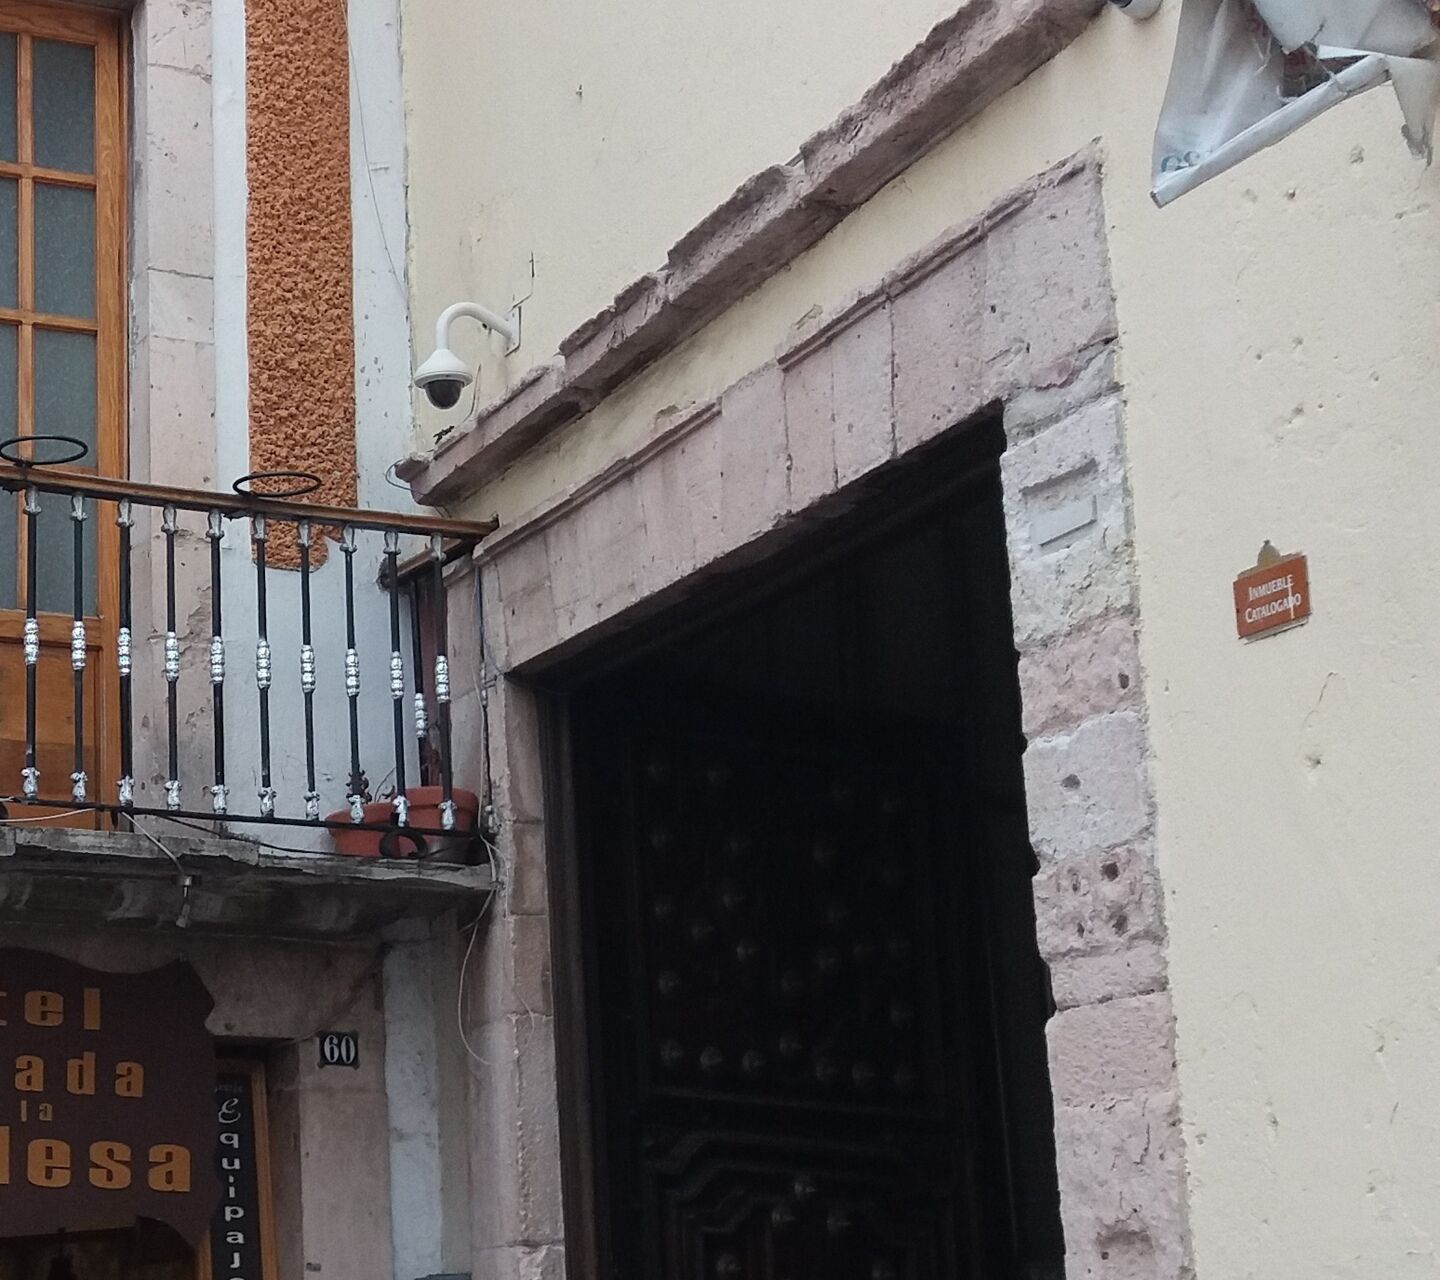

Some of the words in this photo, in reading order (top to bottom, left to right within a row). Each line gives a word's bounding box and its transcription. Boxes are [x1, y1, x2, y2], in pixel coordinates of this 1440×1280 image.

[1248, 574, 1294, 600] INMUEBLE
[1245, 593, 1302, 623] CATALOGADO
[323, 1034, 356, 1064] 60
[20, 1099, 54, 1122] la
